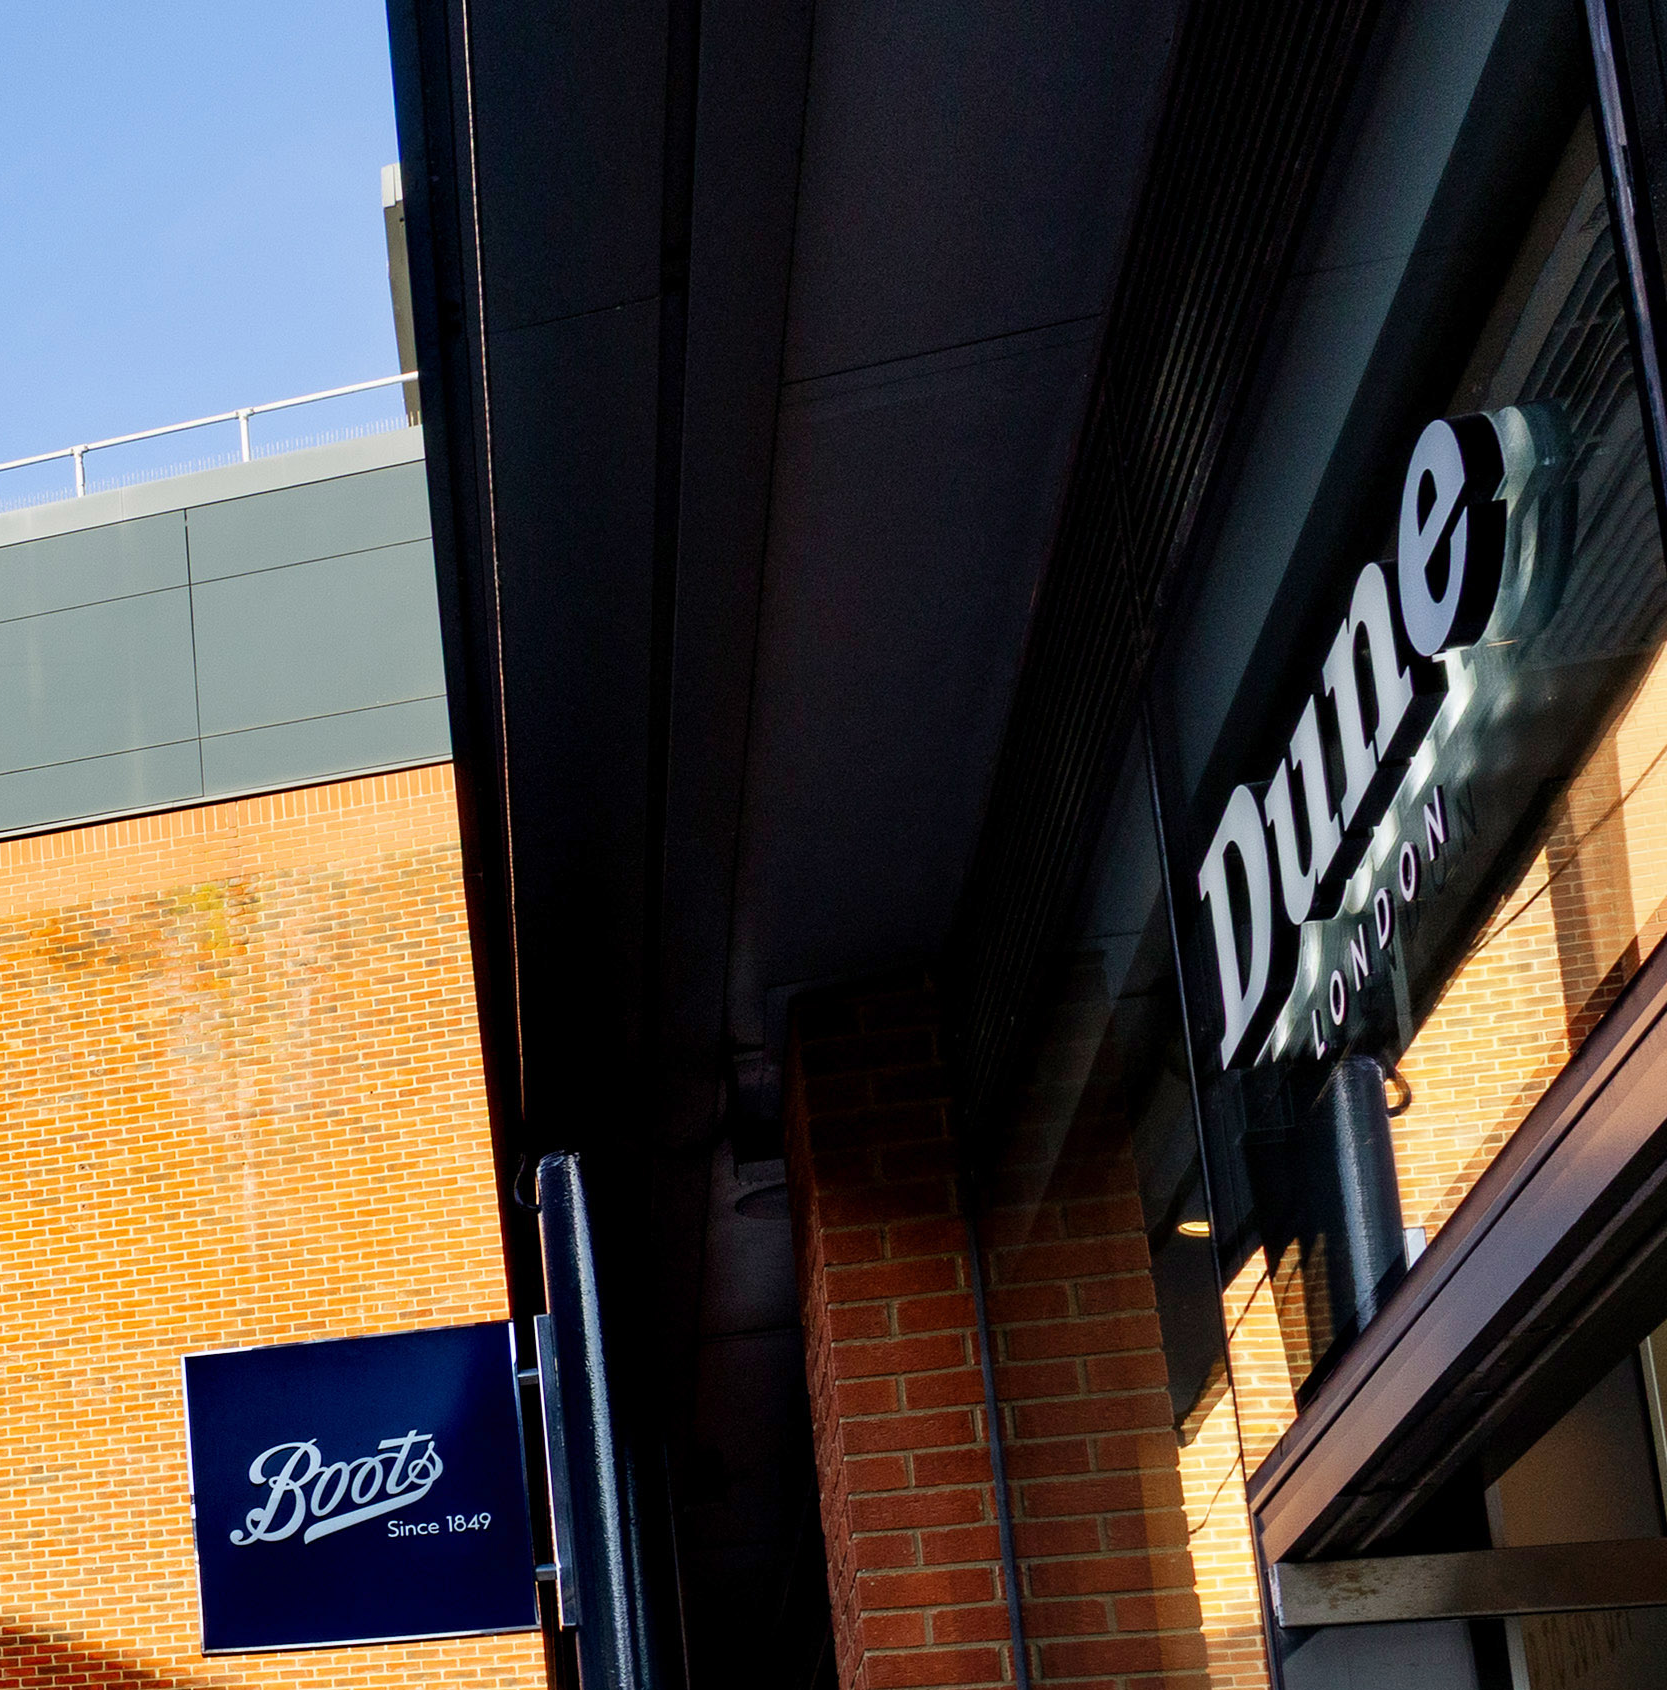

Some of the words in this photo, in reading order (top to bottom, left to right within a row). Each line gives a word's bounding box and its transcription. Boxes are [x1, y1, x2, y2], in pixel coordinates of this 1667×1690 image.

[1199, 418, 1473, 1070] Dune
[1310, 783, 1448, 1062] LONDON
[229, 1428, 444, 1546] Boots
[387, 1519, 440, 1539] Since
[445, 1511, 492, 1533] 1849
